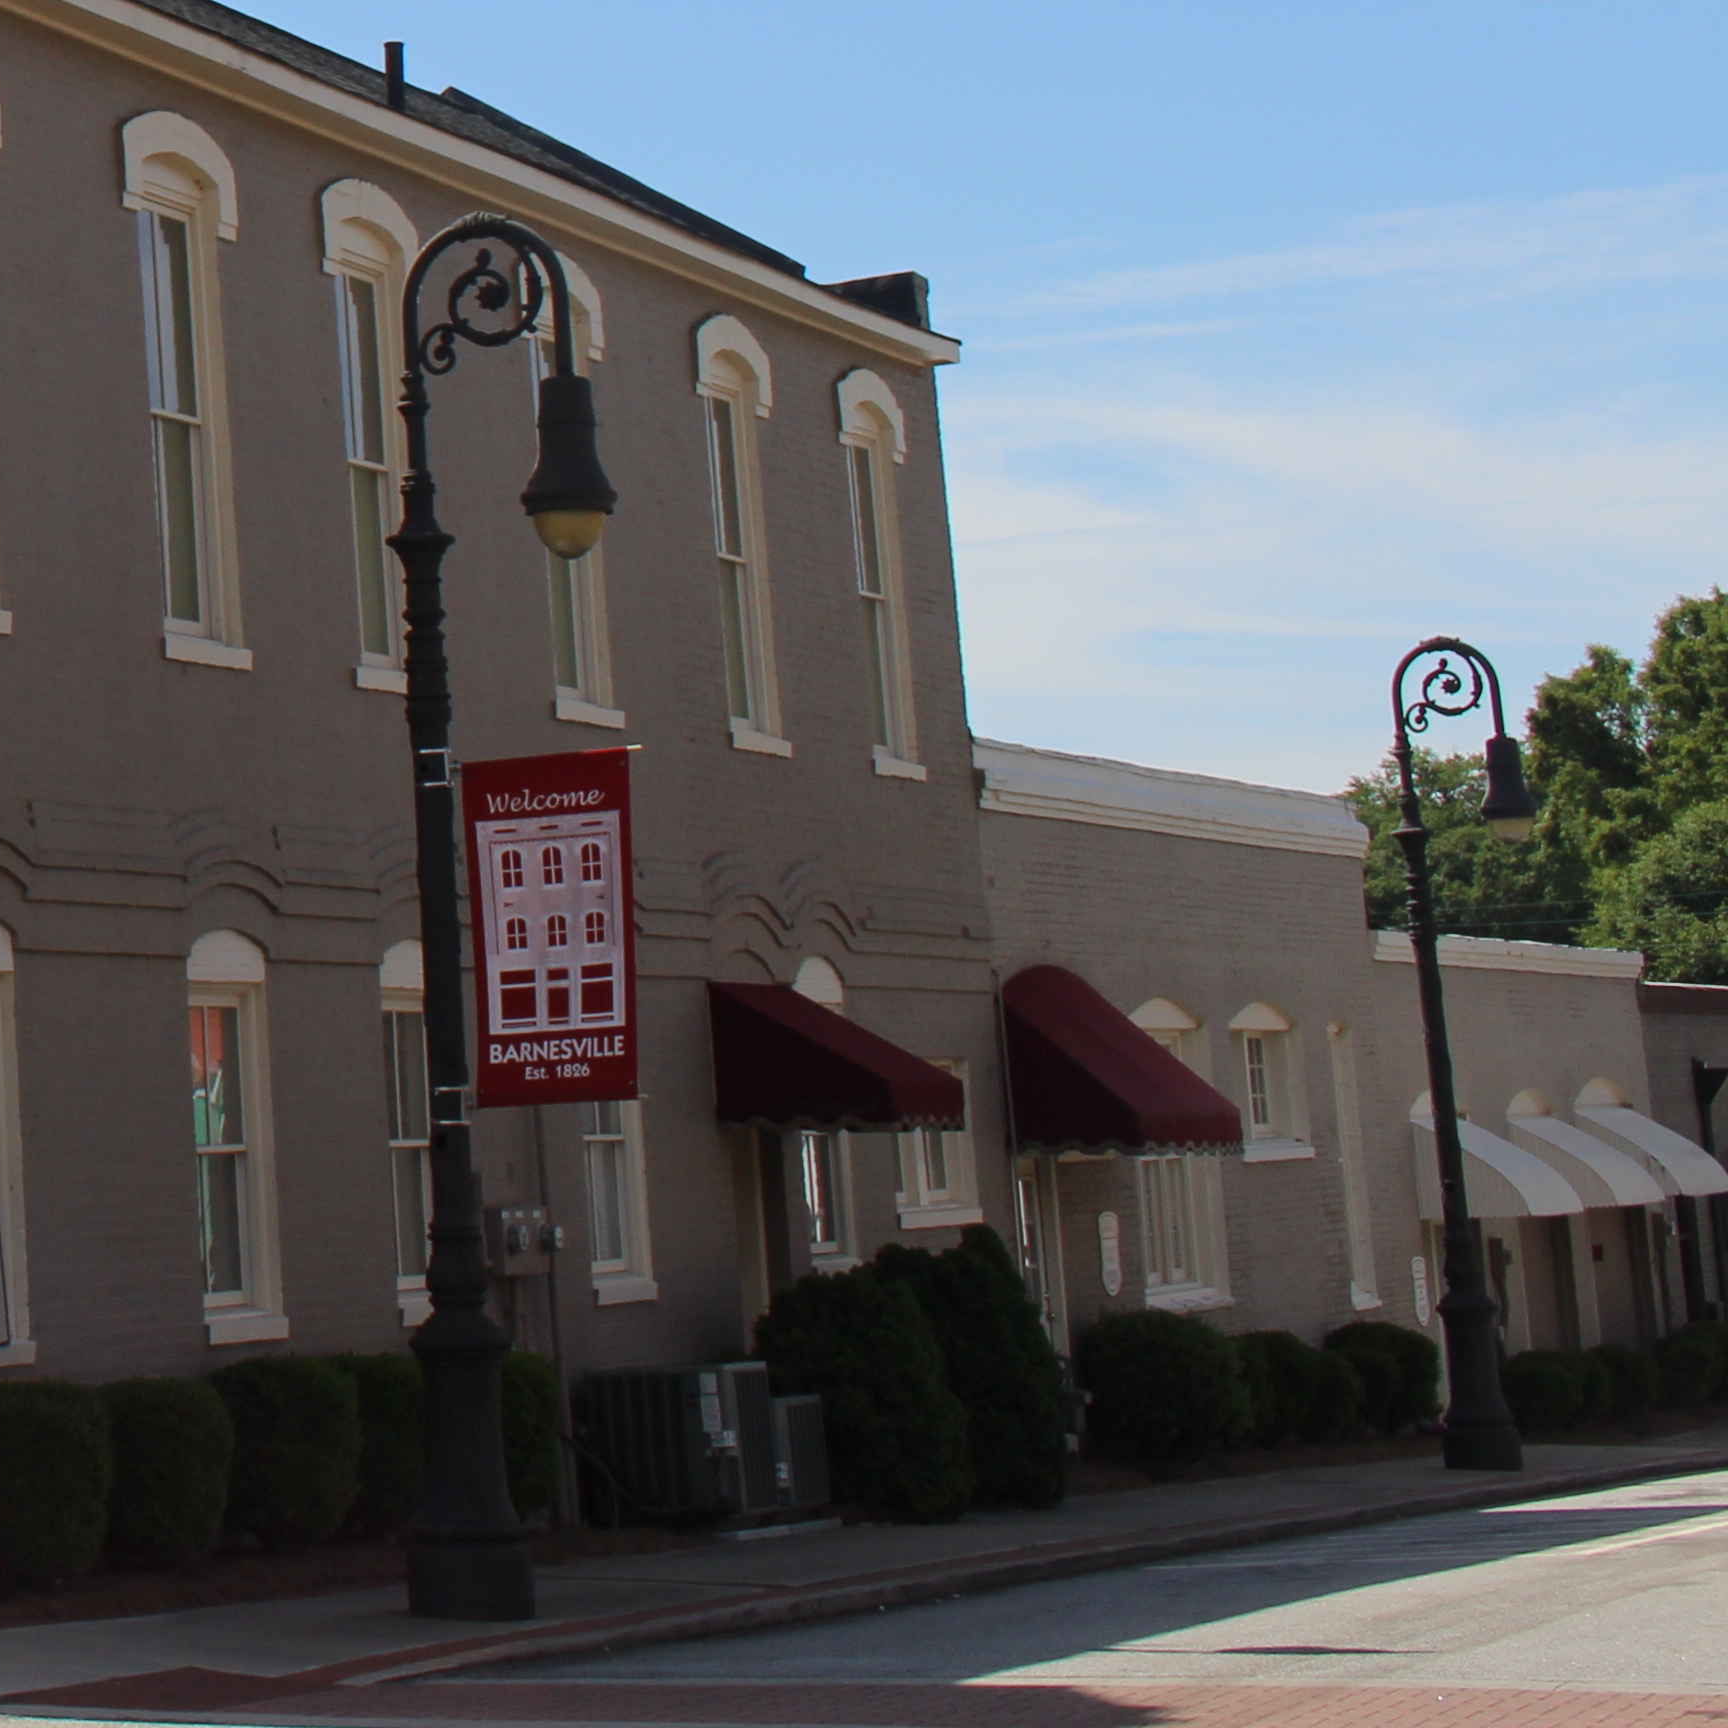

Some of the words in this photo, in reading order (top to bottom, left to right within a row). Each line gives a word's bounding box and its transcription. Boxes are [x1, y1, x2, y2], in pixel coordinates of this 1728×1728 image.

[487, 788, 605, 813] Welcome
[489, 1035, 625, 1064] BARNESVILLE
[525, 1066, 549, 1080] Est.
[555, 1063, 590, 1078] 1826
